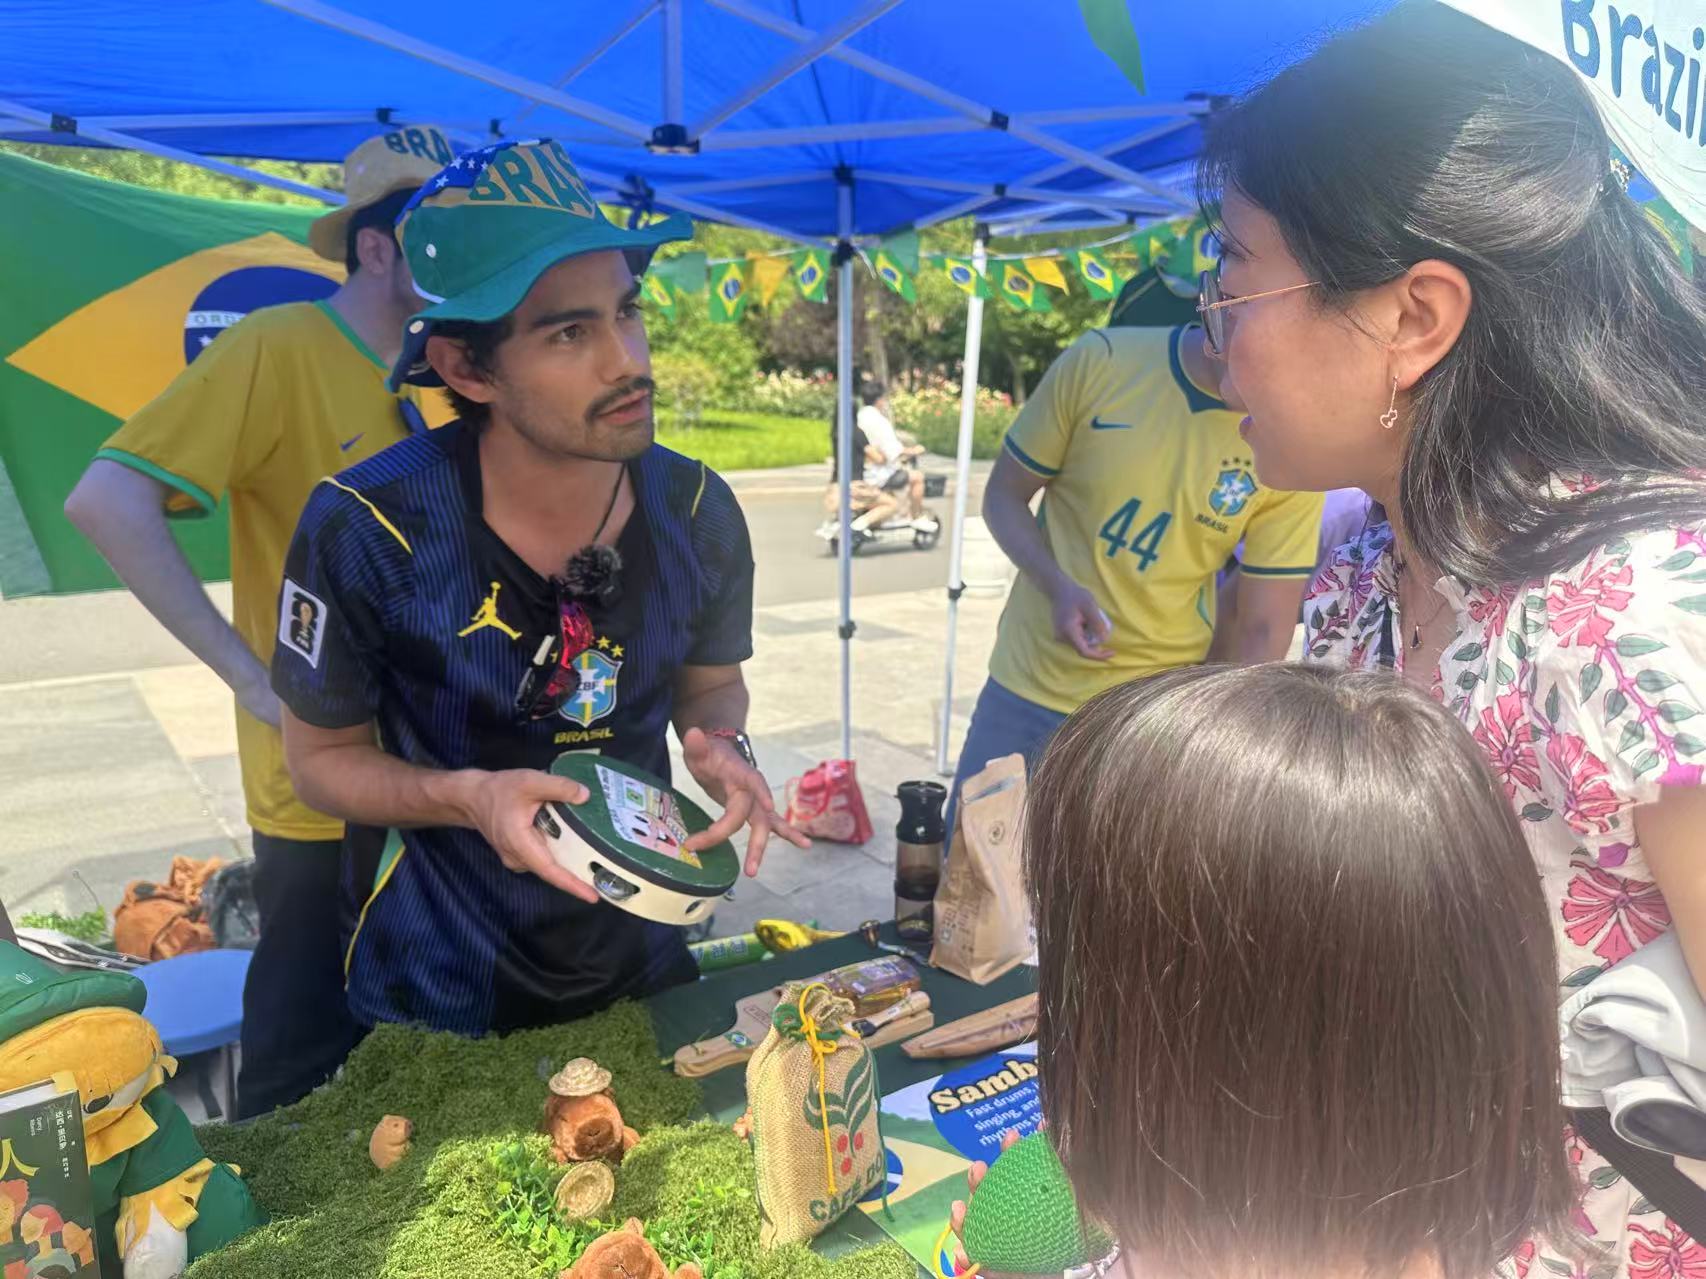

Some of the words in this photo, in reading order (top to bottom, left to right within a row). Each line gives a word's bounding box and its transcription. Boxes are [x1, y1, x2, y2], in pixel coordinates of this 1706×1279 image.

[1098, 496, 1172, 572] 44
[1195, 512, 1228, 534] BRASIL
[554, 727, 614, 744] BRASIL
[929, 1058, 1039, 1114] Samb
[965, 1102, 995, 1119] Fast
[974, 1109, 1023, 1132] singing,
